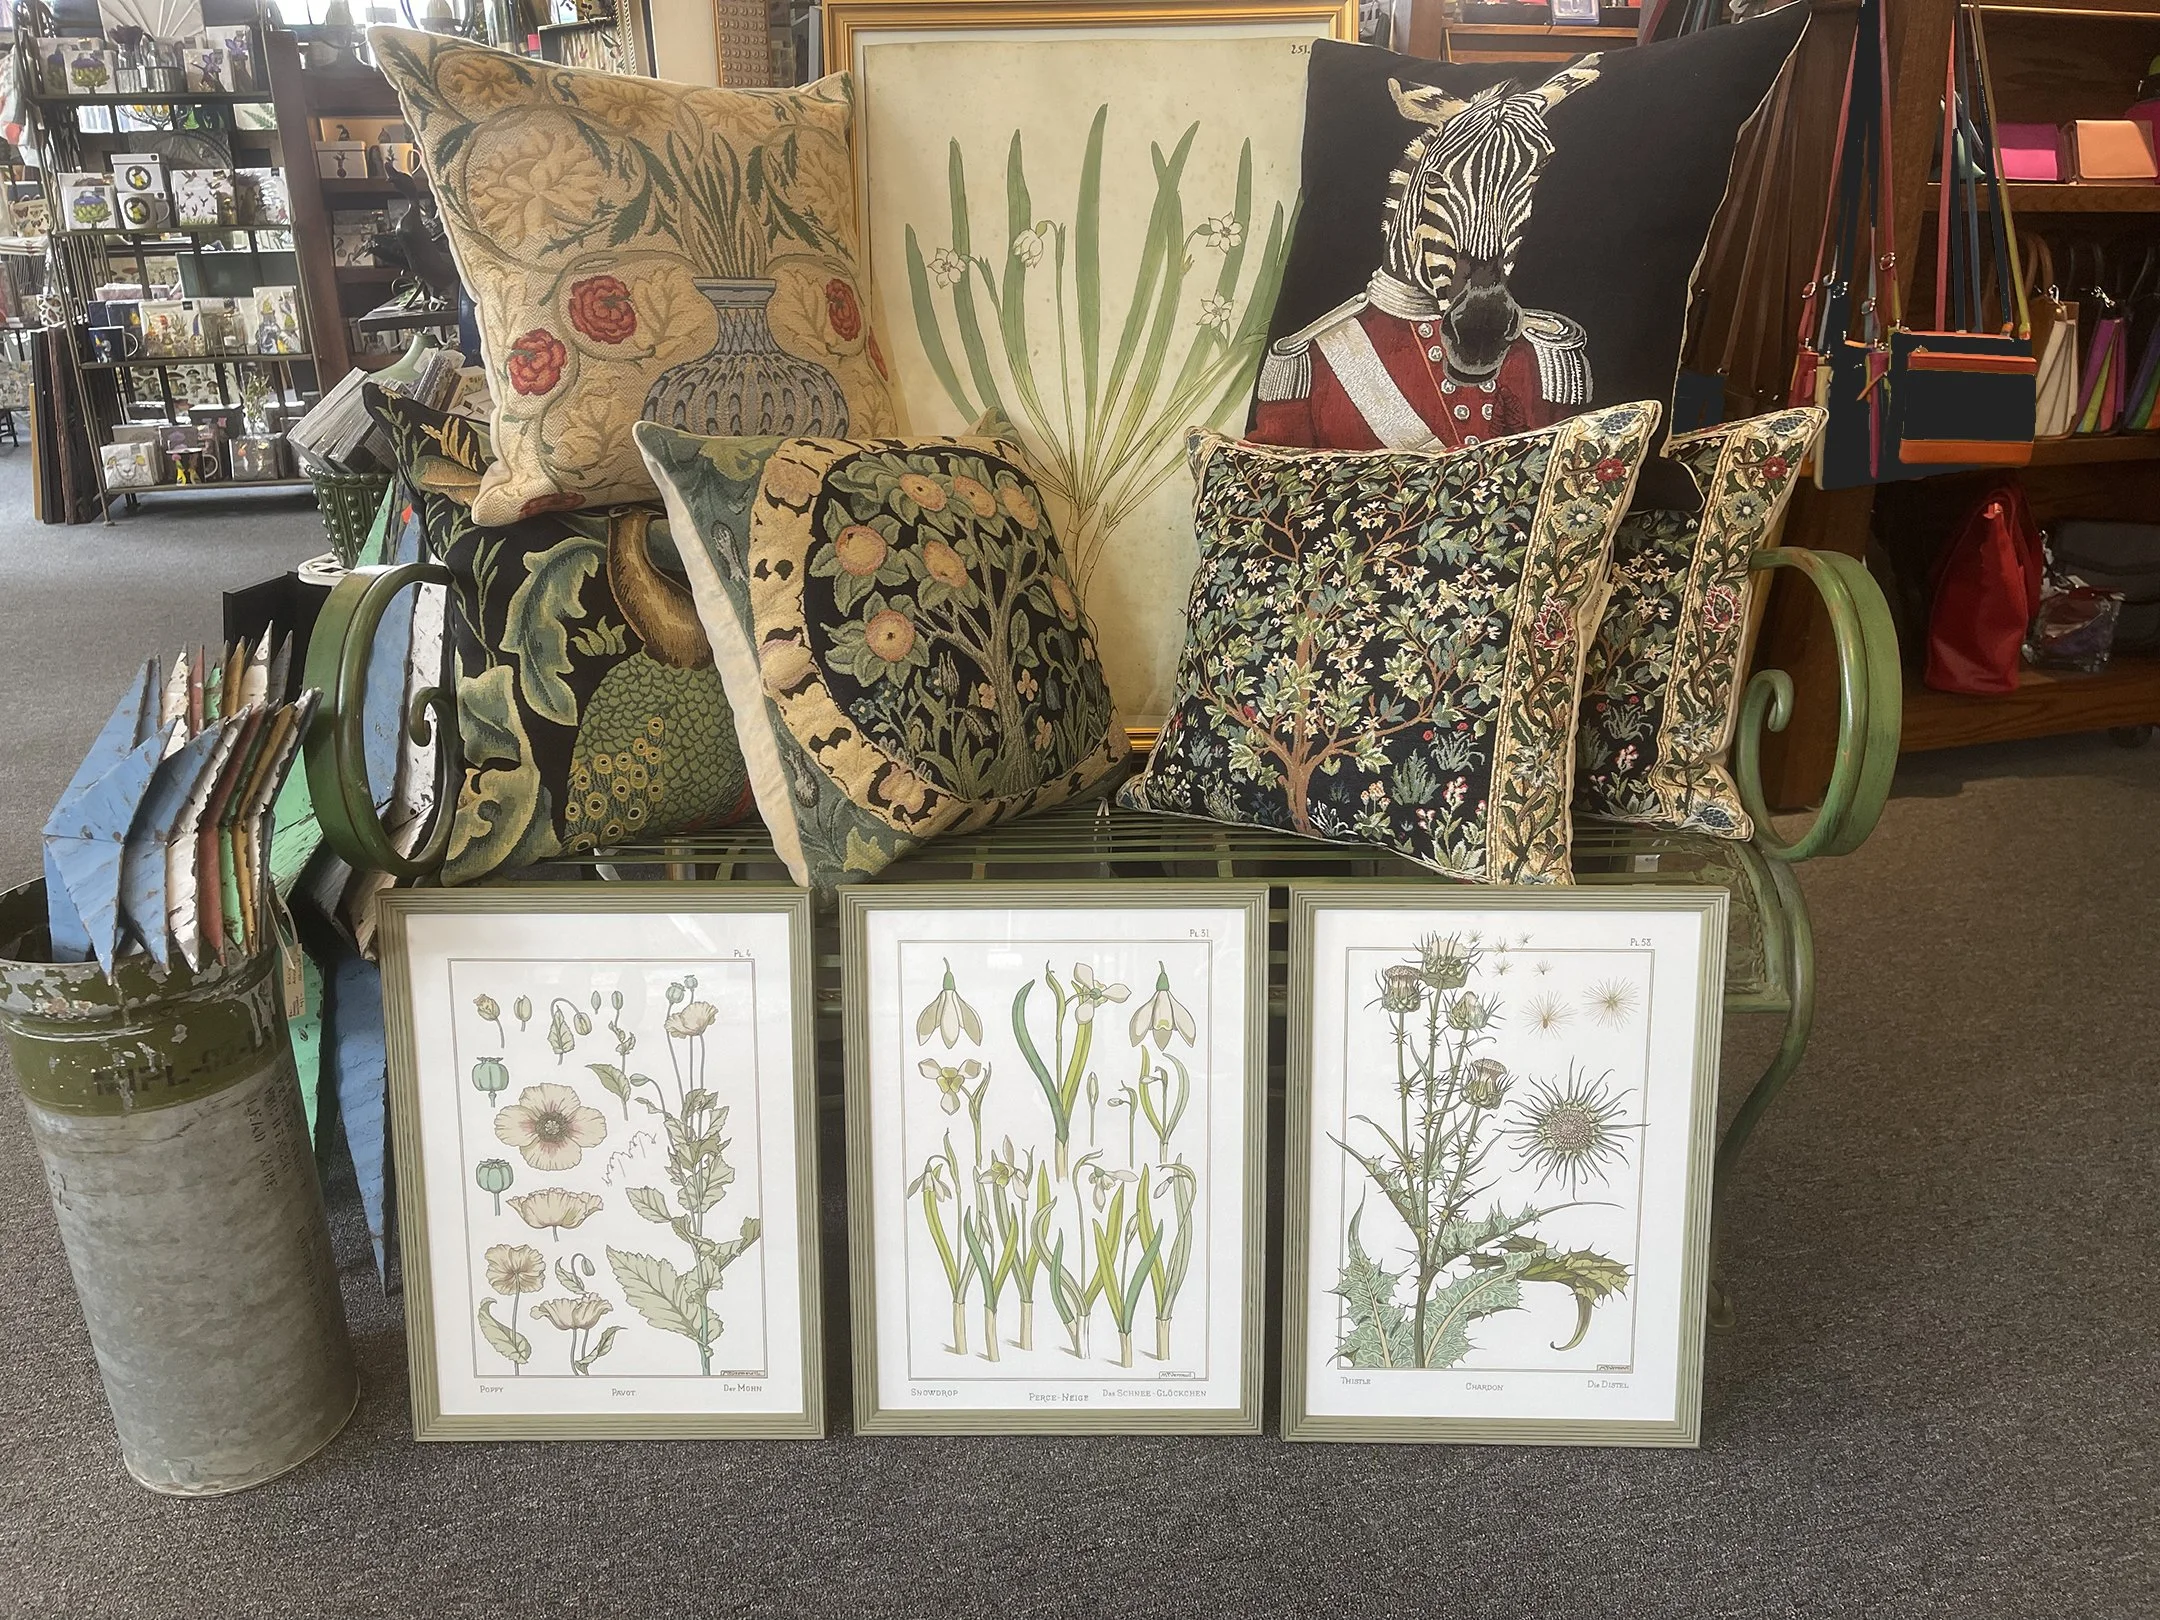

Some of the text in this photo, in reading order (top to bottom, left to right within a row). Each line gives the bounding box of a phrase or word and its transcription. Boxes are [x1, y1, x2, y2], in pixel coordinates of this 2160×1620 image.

[1200, 928, 1209, 938] 31
[1465, 1382, 1504, 1392] CHARDON
[910, 1387, 959, 1398] SNOWDROP
